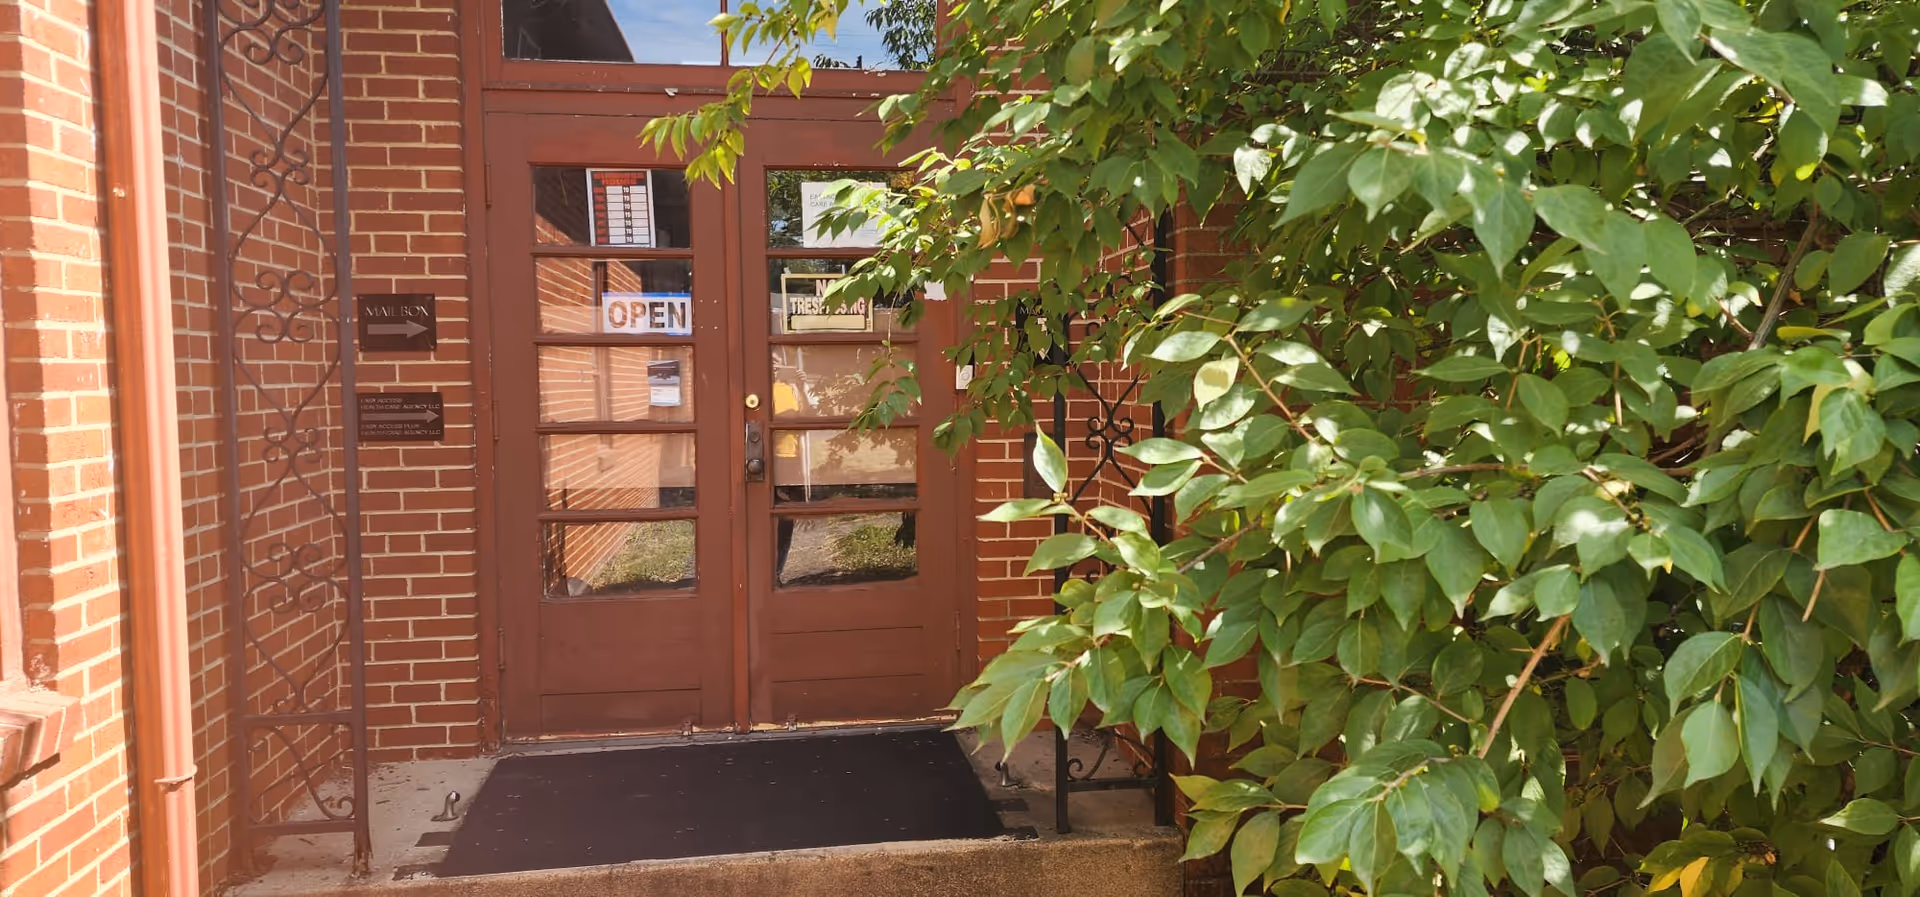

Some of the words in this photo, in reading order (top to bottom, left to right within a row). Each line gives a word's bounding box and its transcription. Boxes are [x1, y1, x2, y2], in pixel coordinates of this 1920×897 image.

[365, 305, 397, 317] MAIL
[400, 305, 429, 317] BOX
[608, 300, 686, 329] OPEN
